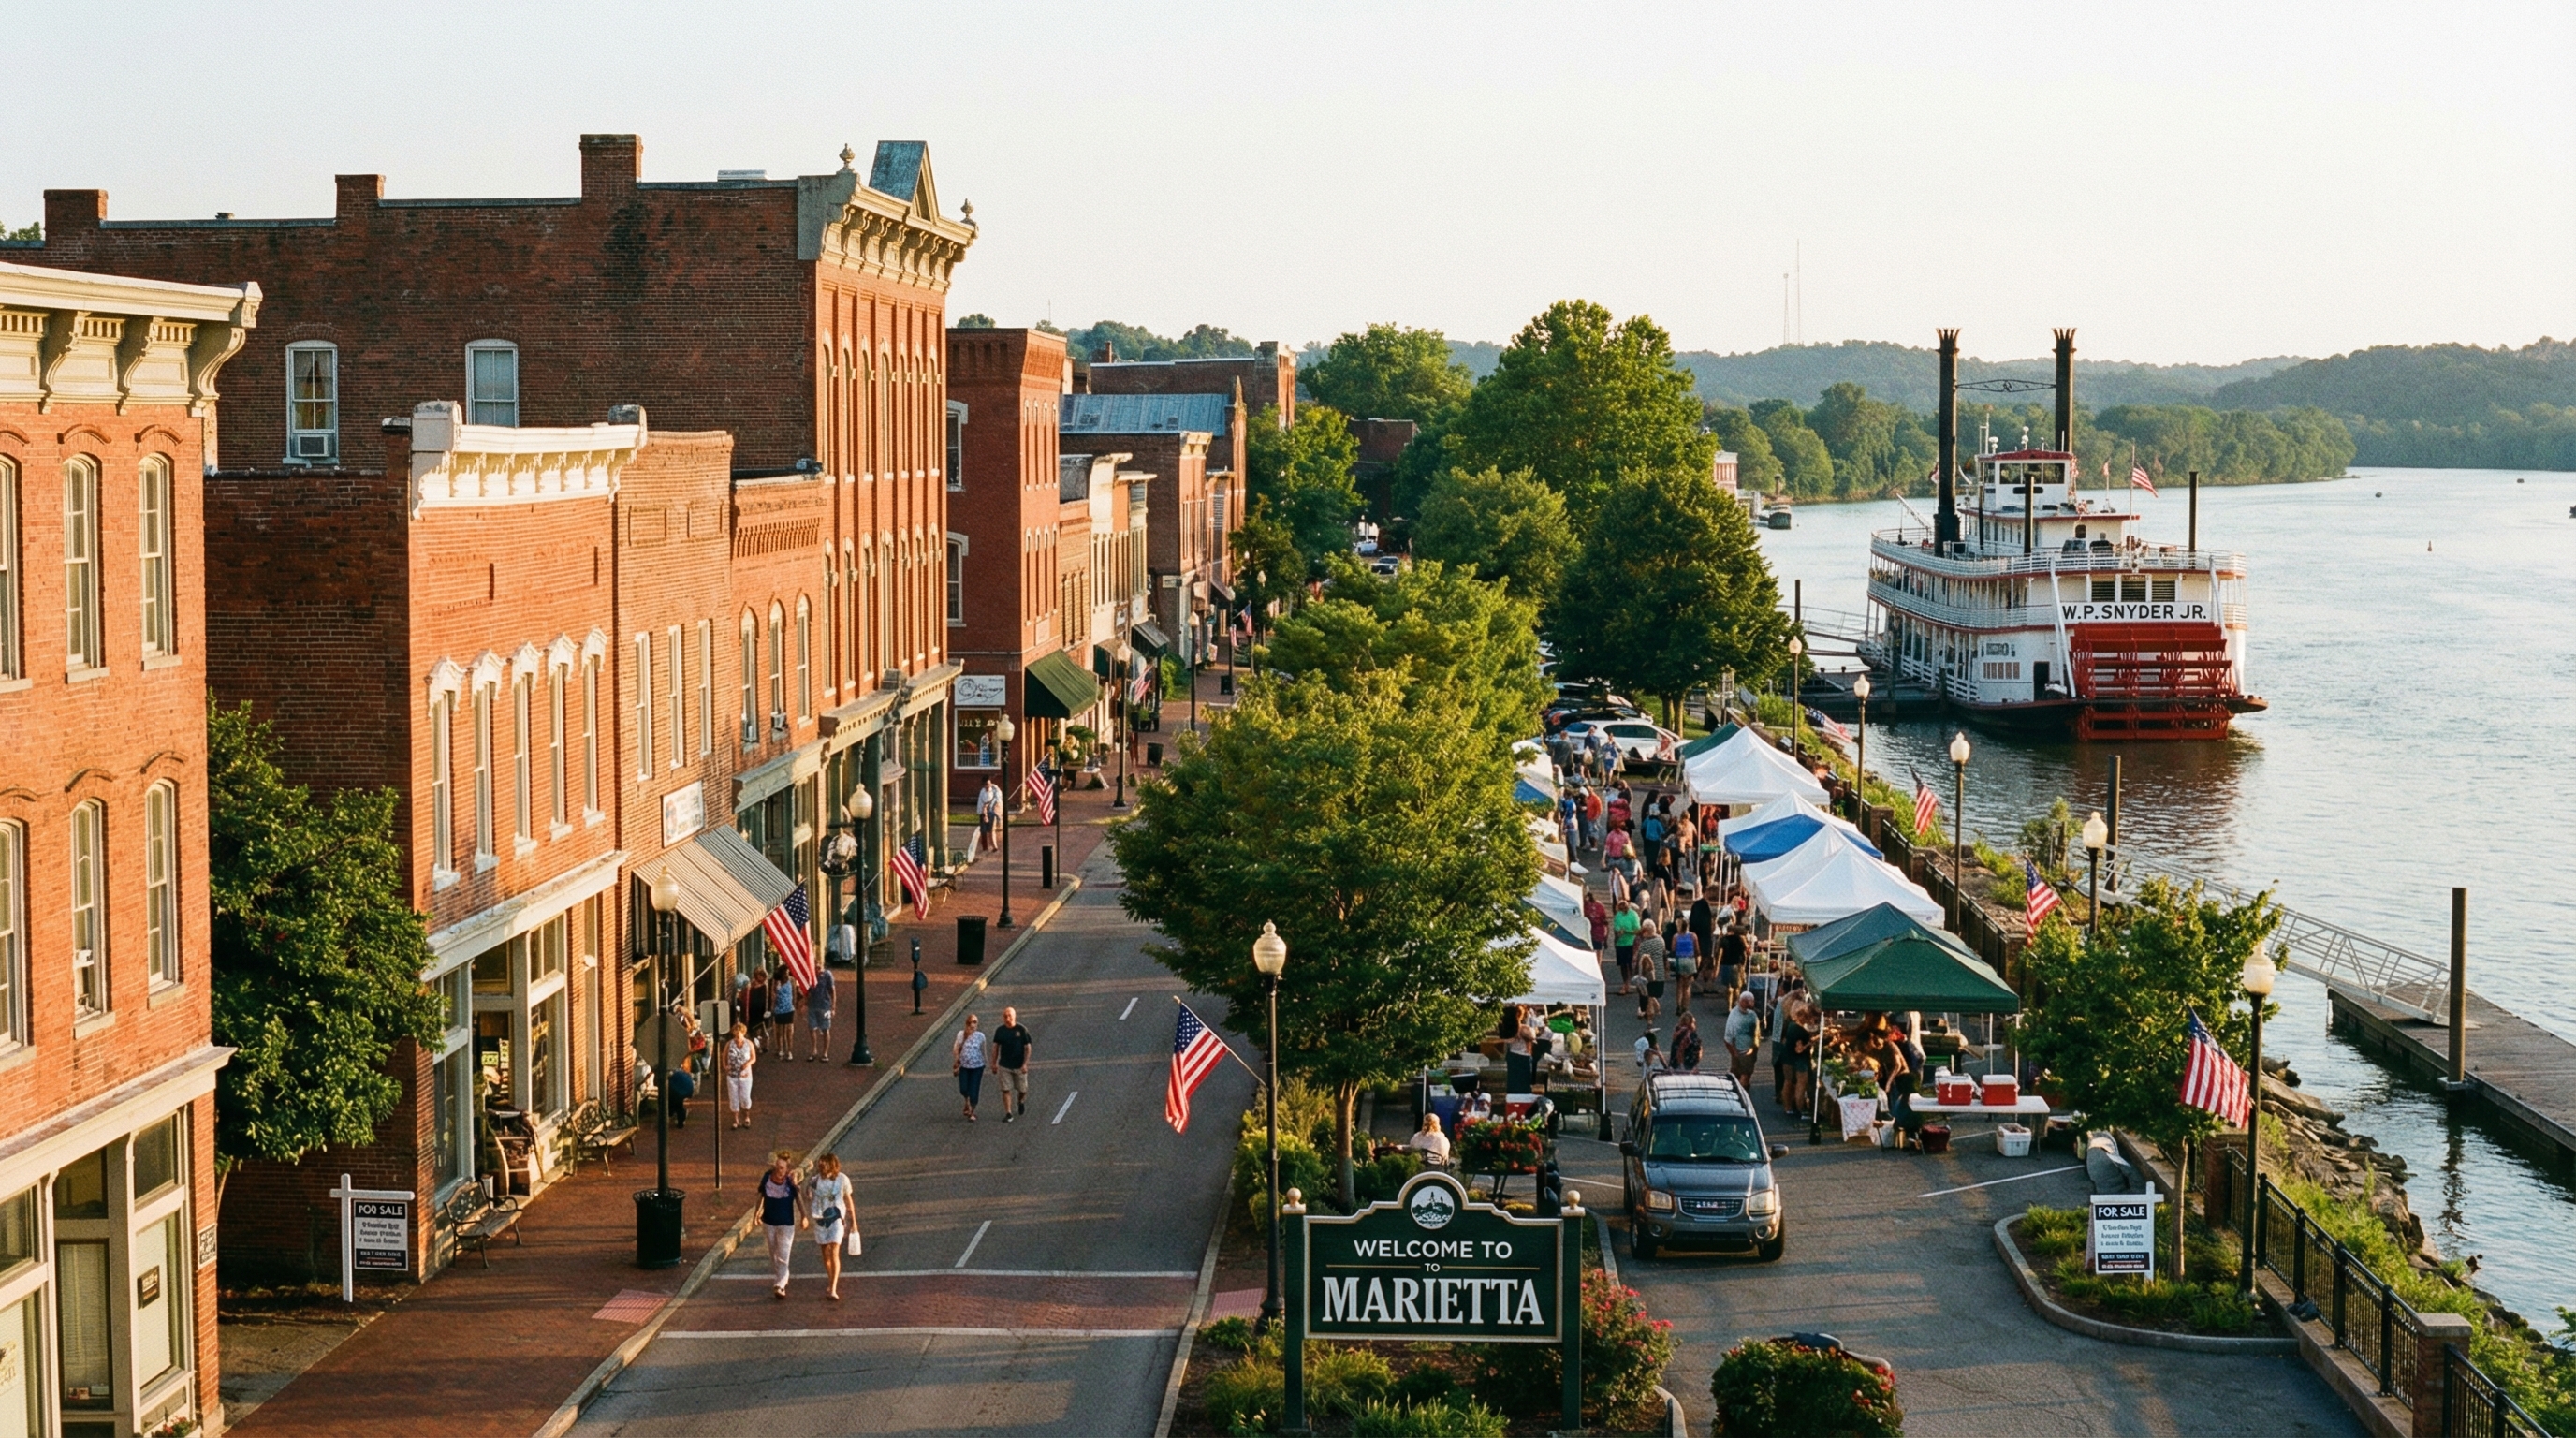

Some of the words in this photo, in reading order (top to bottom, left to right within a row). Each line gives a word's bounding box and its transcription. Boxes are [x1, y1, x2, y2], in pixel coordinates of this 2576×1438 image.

[2180, 604, 2207, 620] JR.
[379, 1205, 403, 1216] SALE
[2098, 1206, 2118, 1218] FOR
[2120, 1206, 2145, 1217] SALE
[1354, 1240, 1474, 1259] WELCOME
[1481, 1240, 1513, 1260] TO
[1425, 1263, 1441, 1272] TO
[1321, 1276, 1545, 1326] MARIETTA
